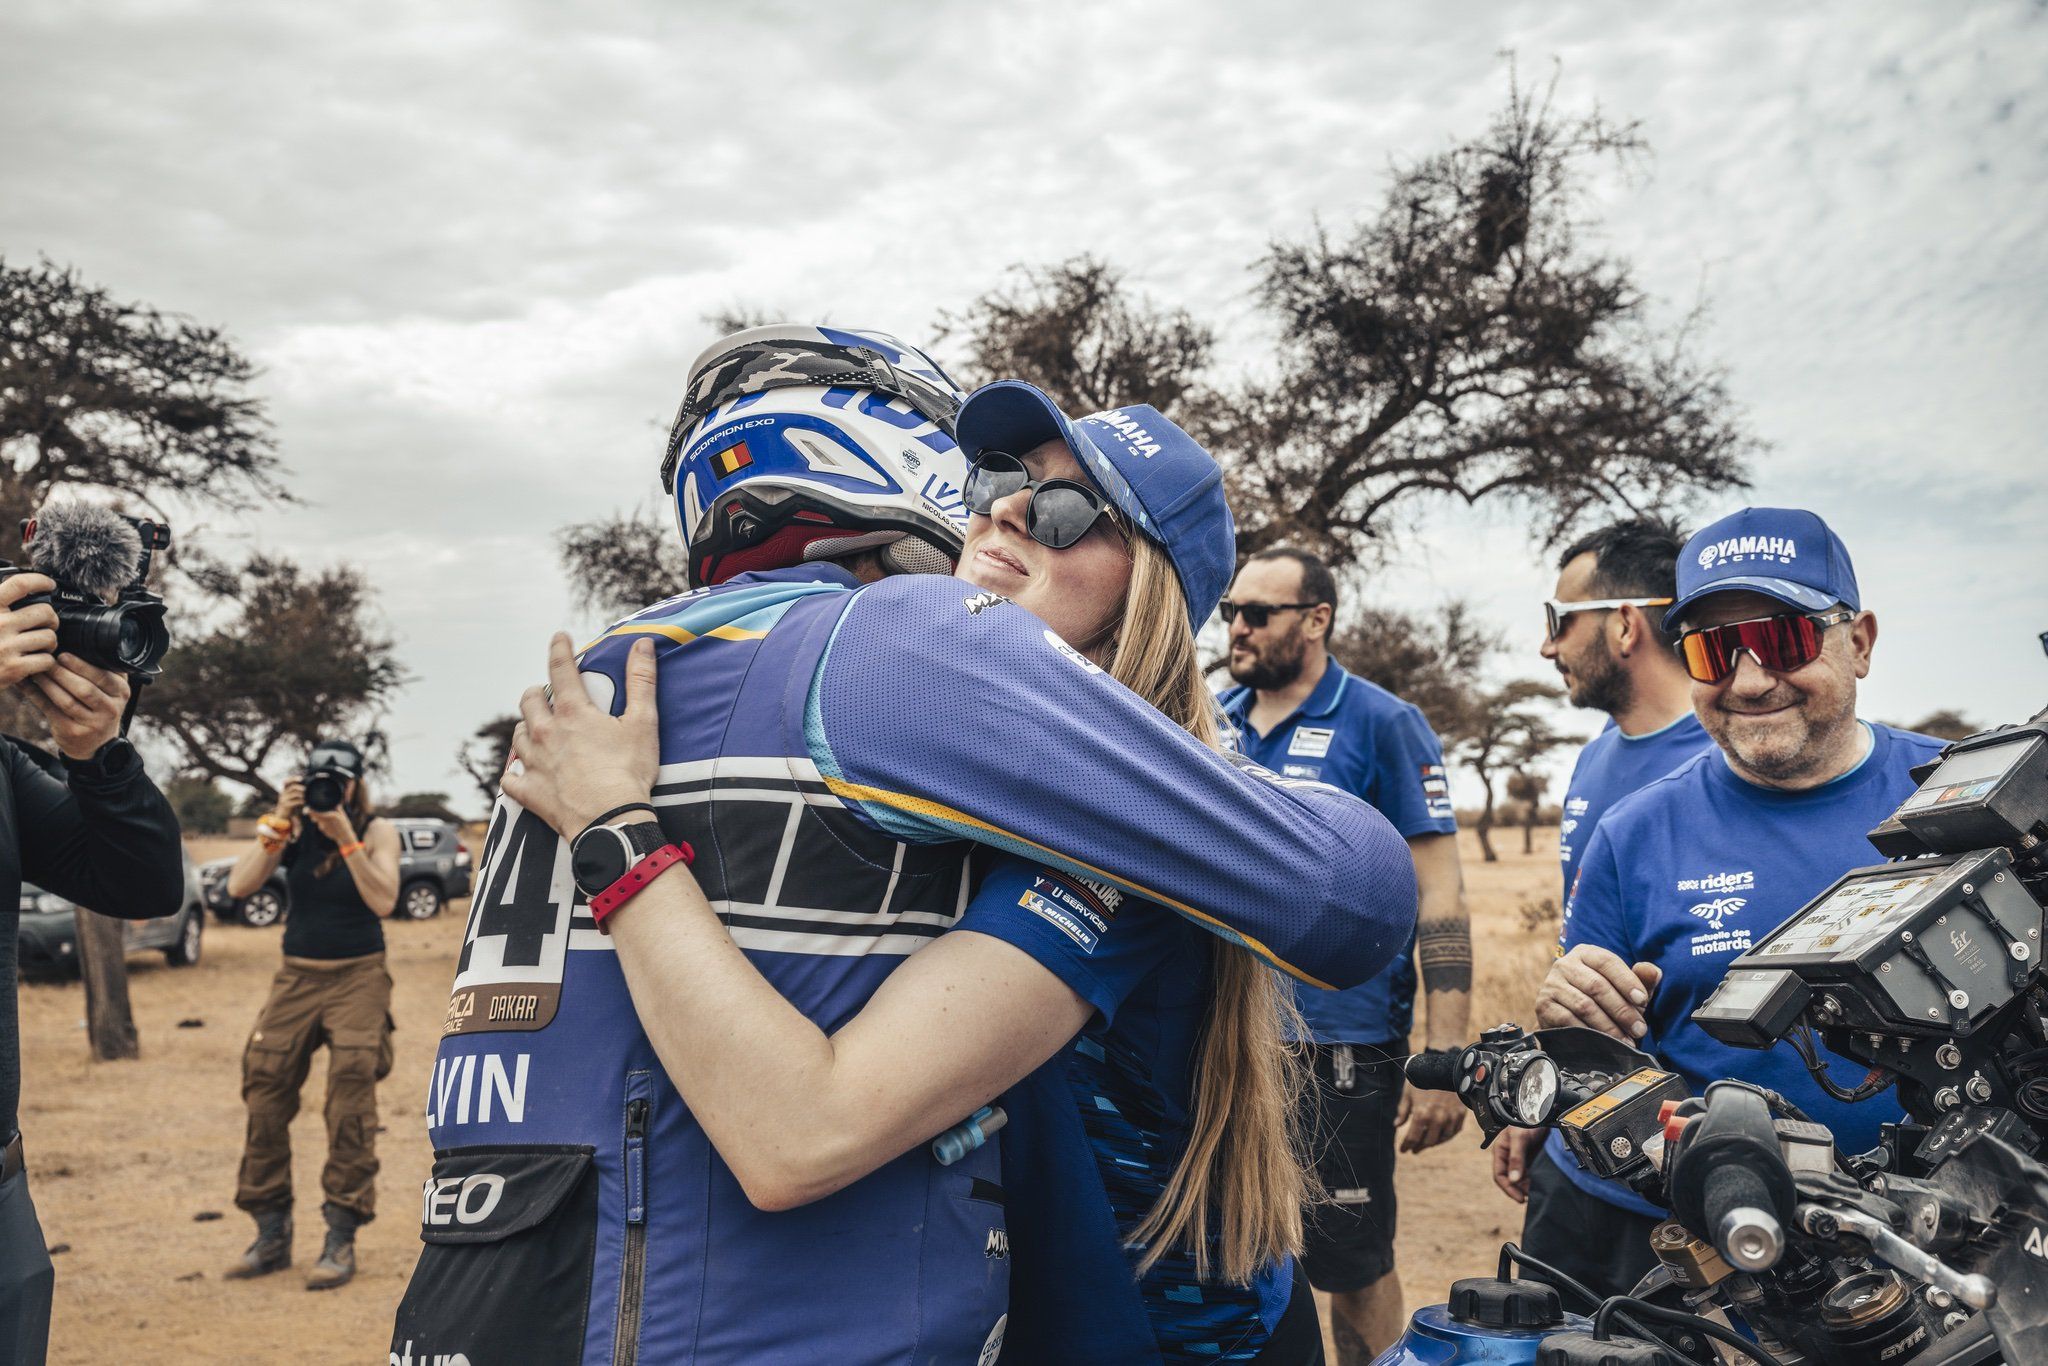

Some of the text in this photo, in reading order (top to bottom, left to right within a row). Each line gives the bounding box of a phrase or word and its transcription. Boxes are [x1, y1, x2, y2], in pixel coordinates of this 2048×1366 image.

[689, 418, 775, 462] SCORPION EXO
[1083, 410, 1162, 459] AMAHA
[1086, 419, 1140, 457] CING
[921, 502, 950, 525] NICOLAS
[1716, 536, 1797, 558] YAMAHA
[1703, 553, 1791, 571] RACING
[1700, 871, 1754, 890] riders
[1062, 893, 1108, 933] SERVICES
[1044, 907, 1091, 945] MICHELIN
[1691, 929, 1751, 944] mutuelle des
[1691, 937, 1752, 956] motards
[488, 995, 538, 1021] DAKAR
